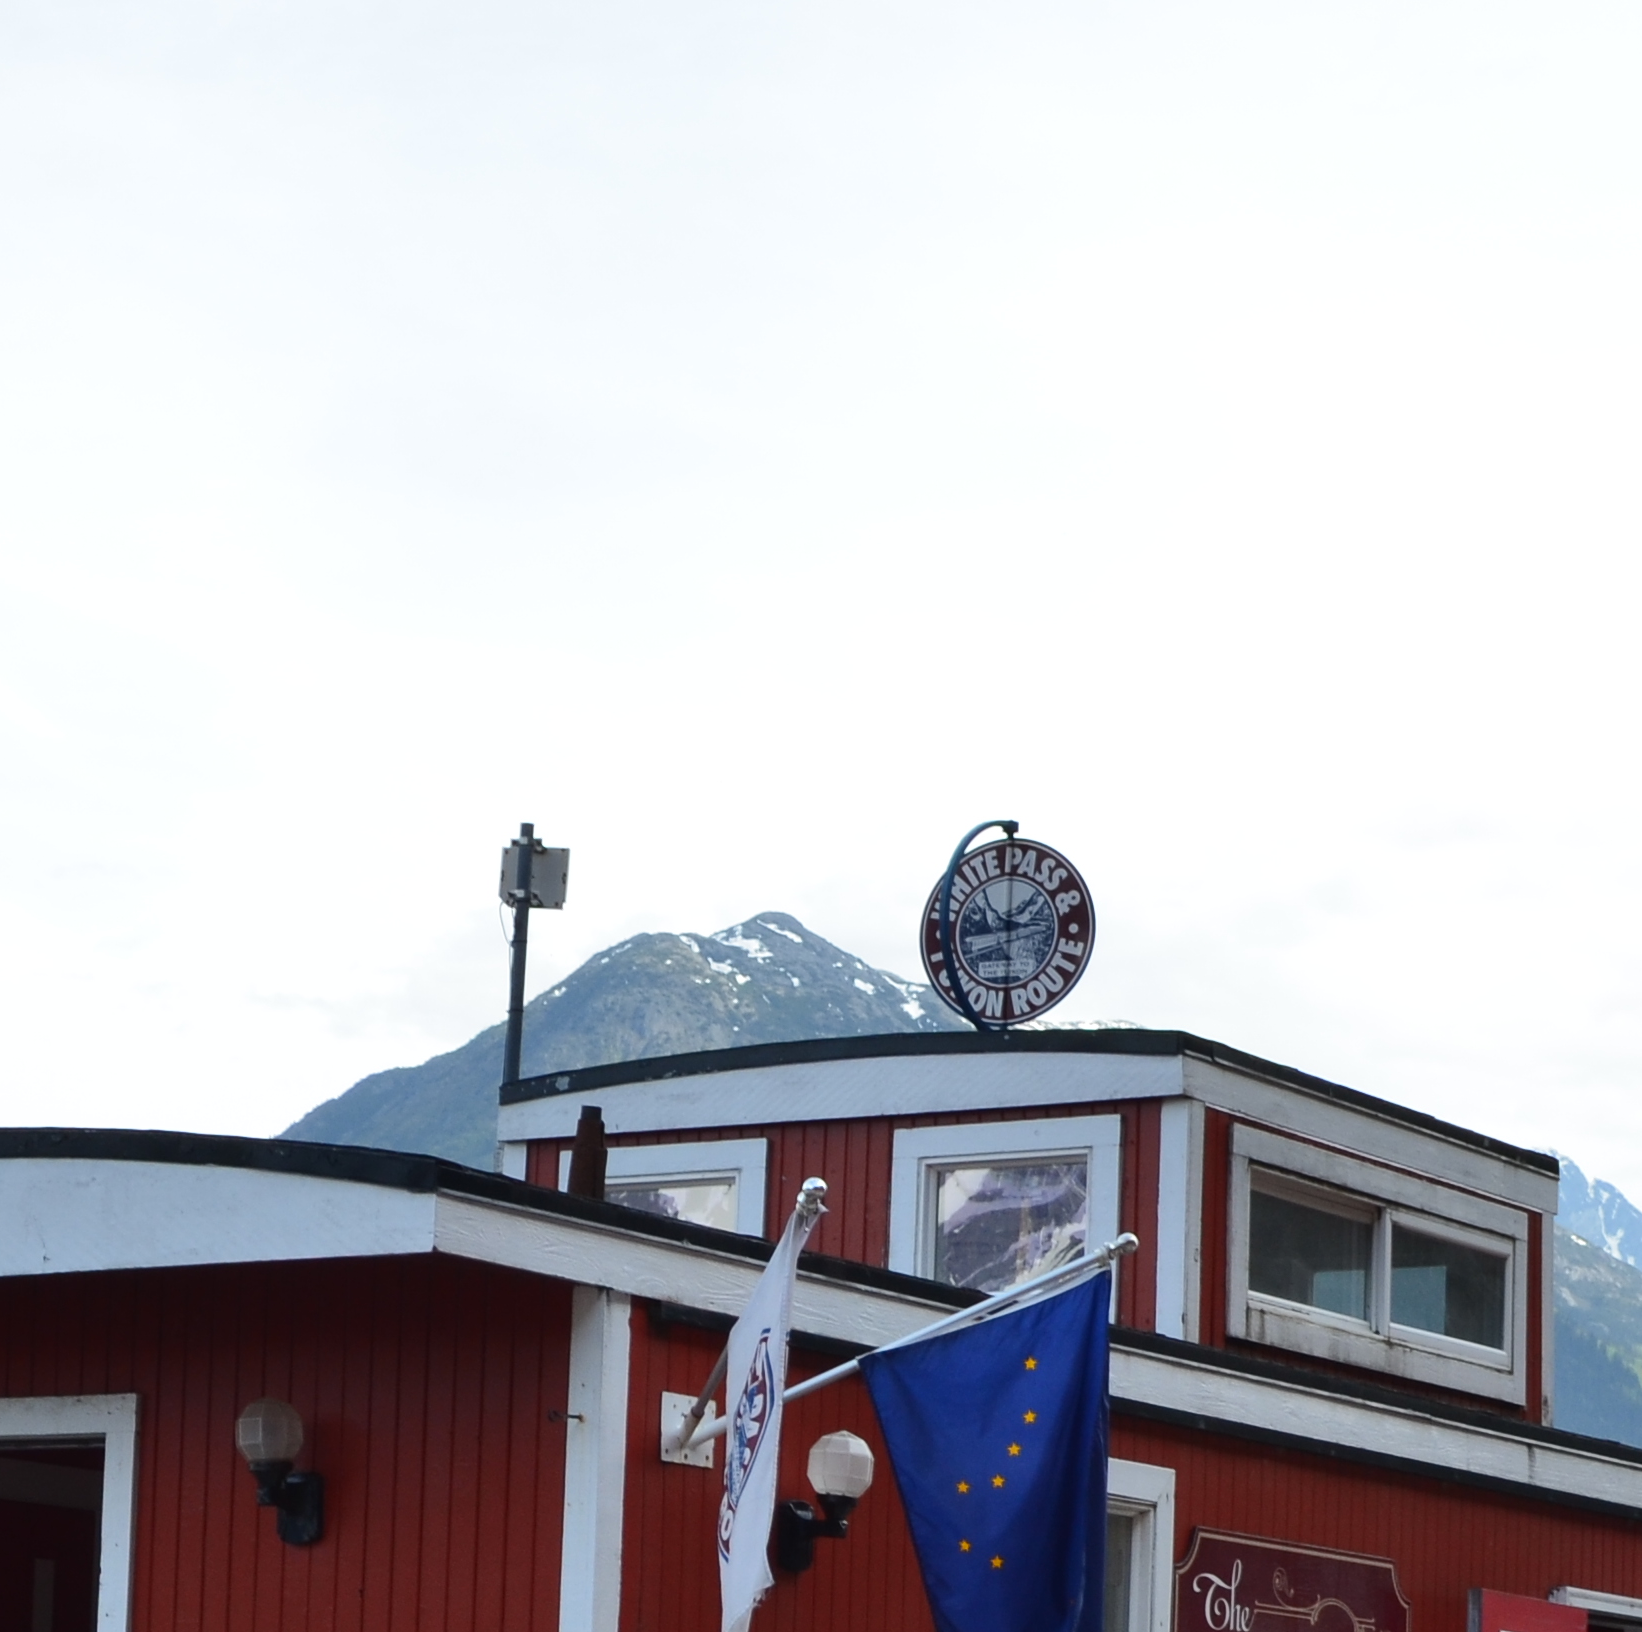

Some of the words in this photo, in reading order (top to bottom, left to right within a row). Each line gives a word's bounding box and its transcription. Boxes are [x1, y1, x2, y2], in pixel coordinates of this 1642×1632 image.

[930, 849, 1001, 922] WHITE
[1004, 846, 1068, 891] PASS
[1055, 889, 1081, 917] &
[1010, 937, 1085, 1016] ROUTE
[1192, 1558, 1256, 1632] The
